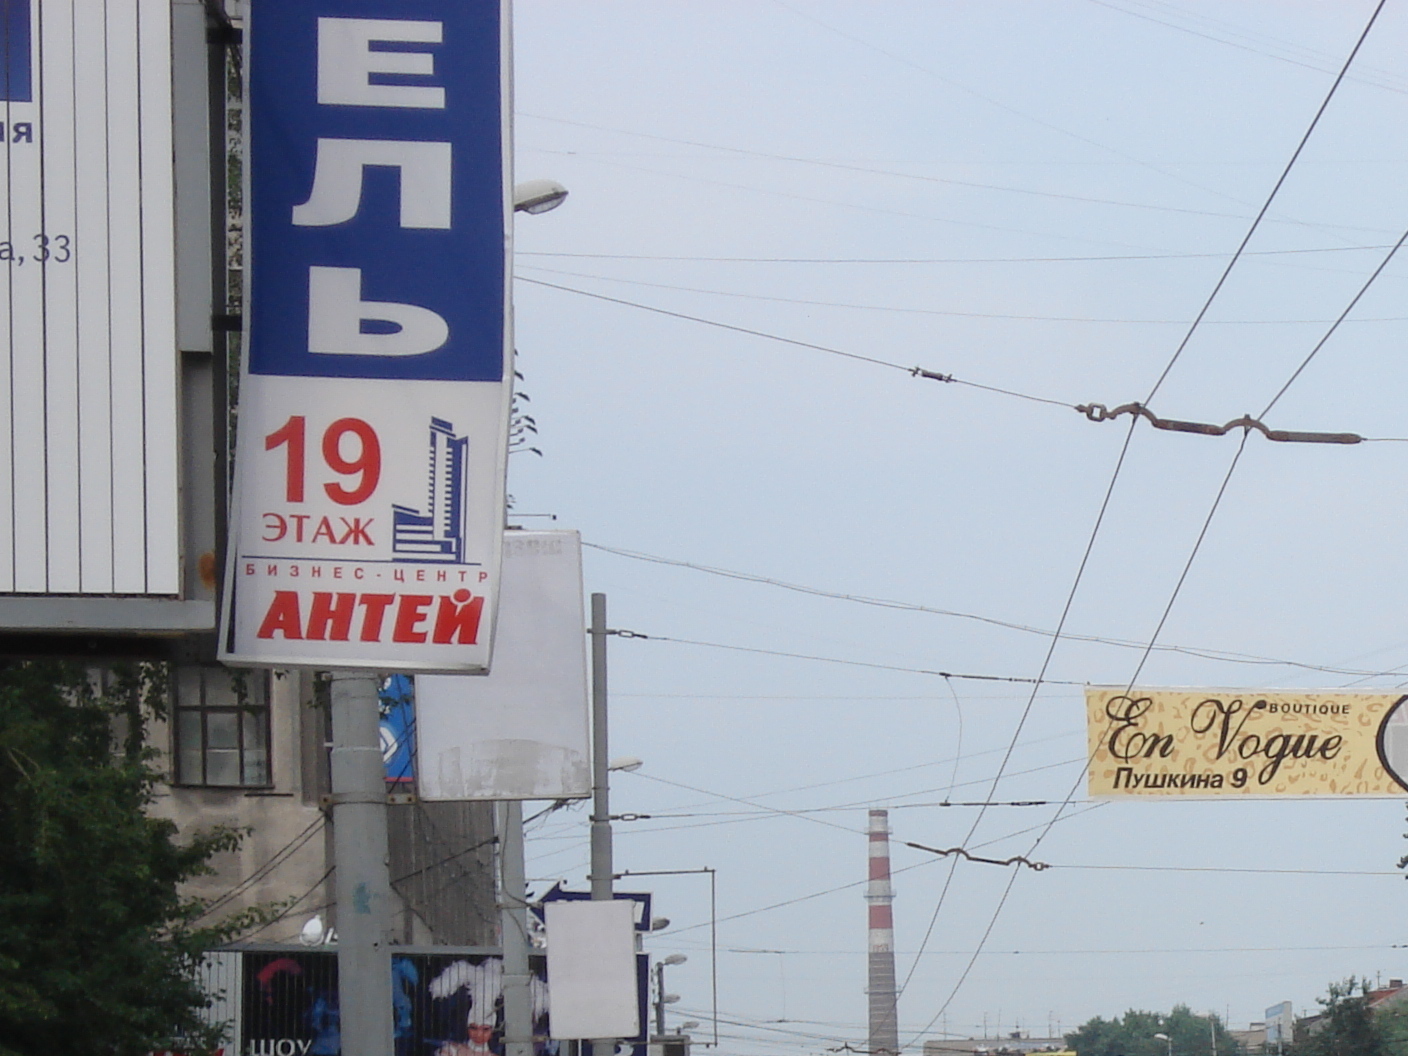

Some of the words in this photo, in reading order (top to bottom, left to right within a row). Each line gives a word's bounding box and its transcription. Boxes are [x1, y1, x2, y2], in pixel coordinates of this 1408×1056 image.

[0, 122, 33, 143] я
[291, 16, 451, 357] ЕЛЬ
[33, 234, 70, 262] 33
[264, 415, 381, 506] 19
[262, 513, 376, 547] ЭТАЖ
[246, 563, 489, 583] БИЗНЕС-ЦЕНТР
[256, 587, 485, 646] АНТЕЙ
[1270, 703, 1350, 715] BOUTIQUE
[1106, 696, 1174, 764] En
[1191, 699, 1342, 786] Vogue
[1113, 767, 1224, 789] Пушкина
[1231, 768, 1248, 788] 9
